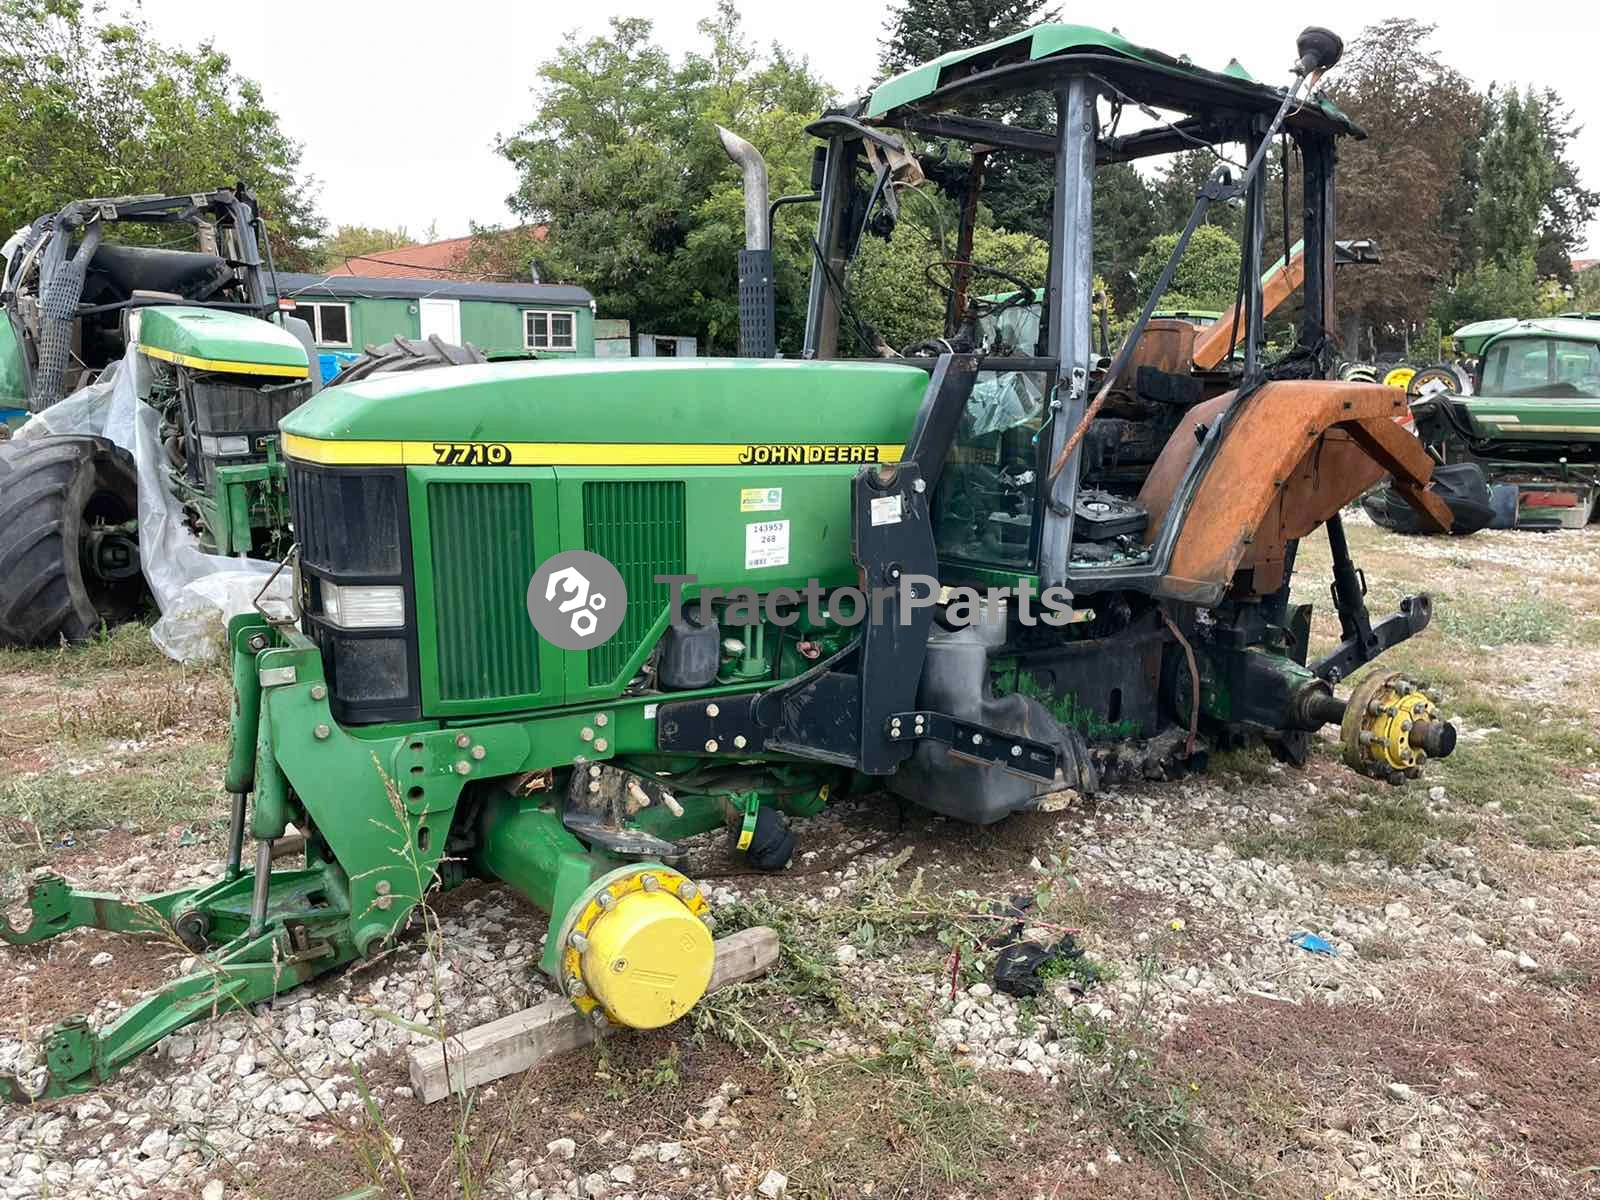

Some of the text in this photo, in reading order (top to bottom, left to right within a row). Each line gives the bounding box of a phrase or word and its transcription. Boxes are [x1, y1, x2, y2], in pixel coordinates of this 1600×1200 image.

[433, 444, 512, 465] 7710
[738, 446, 879, 464] JOHN DEERE
